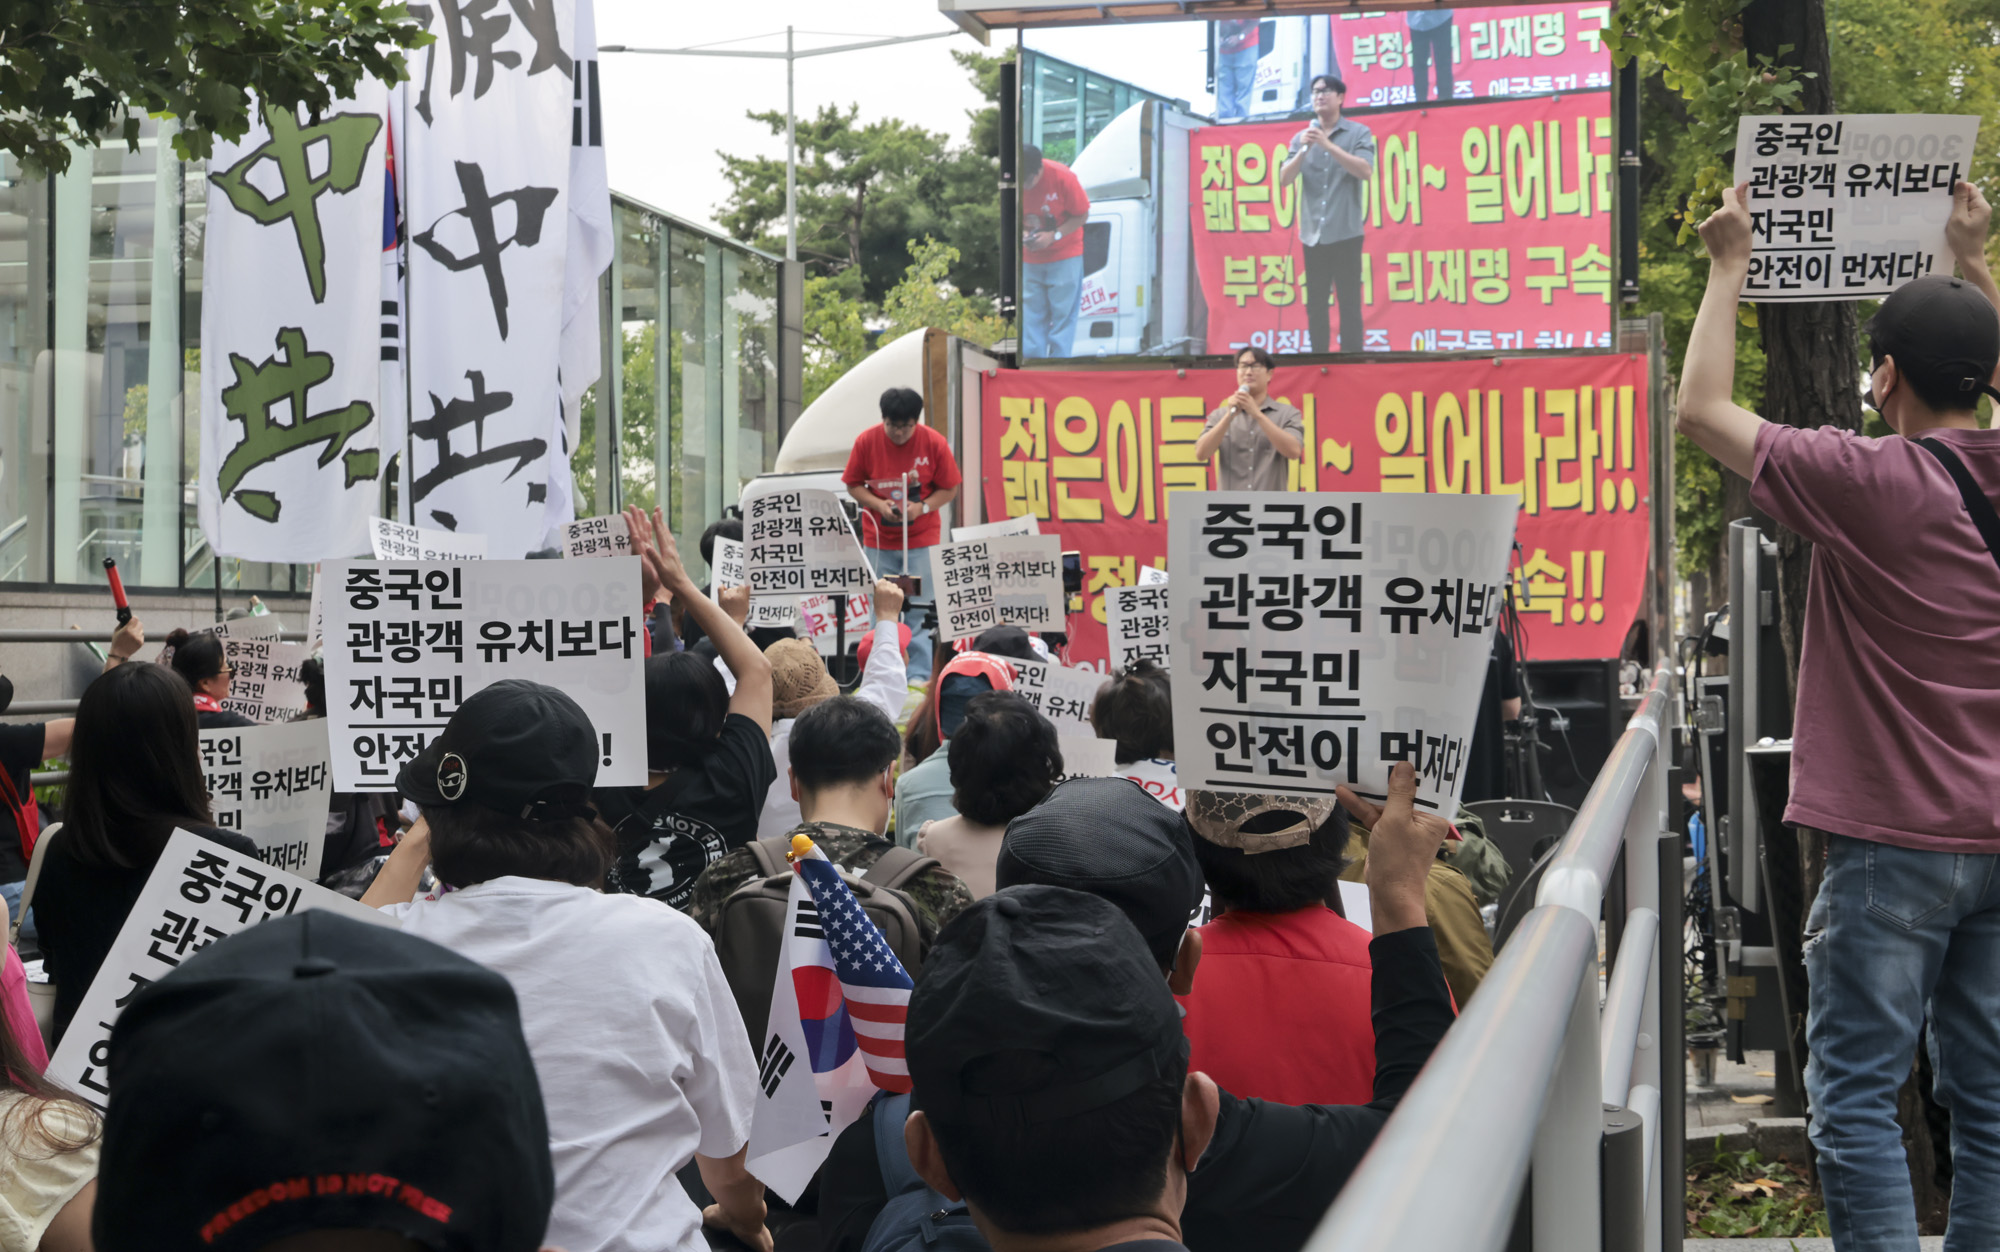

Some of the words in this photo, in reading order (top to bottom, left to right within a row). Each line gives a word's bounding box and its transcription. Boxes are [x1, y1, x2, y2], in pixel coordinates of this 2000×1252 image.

[1470, 12, 1565, 61] 리재명
[1755, 121, 1842, 156] 중국인
[1749, 163, 1836, 199] 관광객
[1845, 162, 1961, 197] 유치보다
[1751, 208, 1833, 244] 자국민
[1387, 248, 1510, 304] 리재명
[1746, 253, 1831, 289] 안전이
[1842, 251, 1933, 287] 먼저다!
[208, 104, 383, 523] 中共
[1374, 385, 1636, 515] 일어나라!!
[751, 492, 801, 516] 중국인
[378, 521, 419, 541] 중국인
[568, 519, 608, 539] 중국인
[751, 517, 802, 540] 관광객
[809, 516, 852, 537] 유치
[1202, 503, 1362, 560] 중국인
[570, 536, 611, 557] 관광객
[750, 542, 804, 564] 자국민
[941, 543, 988, 566] 중국인
[345, 567, 463, 610] 중국인
[750, 569, 804, 590] 안전이
[811, 566, 872, 588] 먼저다!
[944, 563, 990, 587] 관광객
[996, 561, 1057, 579] 유치보다
[1504, 547, 1605, 625] 속!!
[947, 585, 993, 607] 자국민
[1201, 573, 1362, 633] 관광객
[950, 607, 995, 631] 안전이
[1000, 606, 1049, 623] 먼저다!
[225, 641, 269, 660] 중국인
[346, 619, 463, 663] 관광객
[476, 616, 636, 662] 유치보다
[1123, 643, 1169, 668] 자국
[1013, 662, 1046, 688] 국인
[1202, 648, 1360, 706] 자국민
[349, 675, 463, 718] 자국민
[200, 735, 242, 767] 국인
[353, 733, 428, 776] 안전
[1206, 721, 1358, 784] 안전이
[250, 760, 327, 803] 유치보다
[665, 815, 702, 836] NOT
[701, 832, 724, 862] FRE
[180, 849, 302, 924] 중국인
[346, 1172, 400, 1199] NOT
